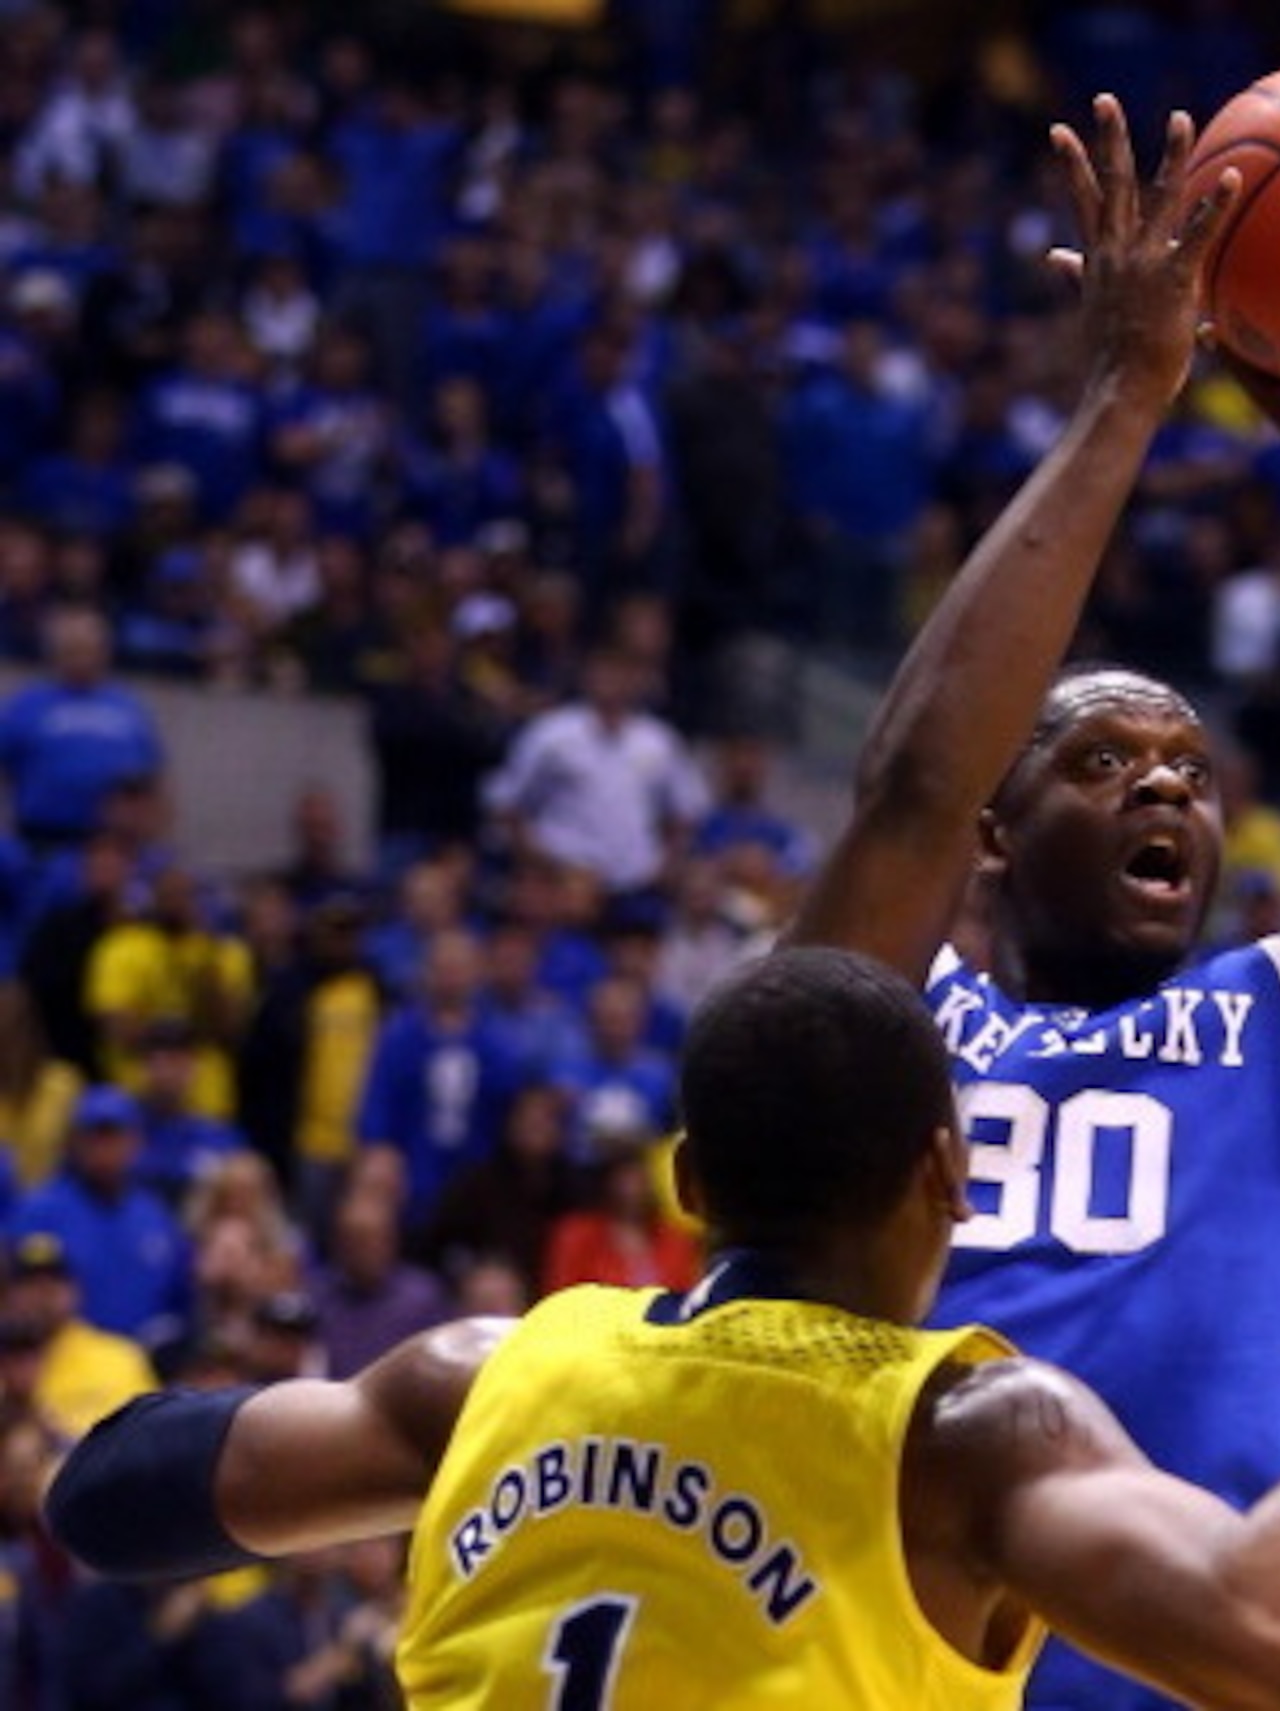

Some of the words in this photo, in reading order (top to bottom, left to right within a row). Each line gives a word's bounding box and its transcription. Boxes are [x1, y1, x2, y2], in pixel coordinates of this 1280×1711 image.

[950, 1080, 1174, 1256] 30
[451, 1434, 820, 1627] ROBINSON
[541, 1588, 639, 1711] 1
